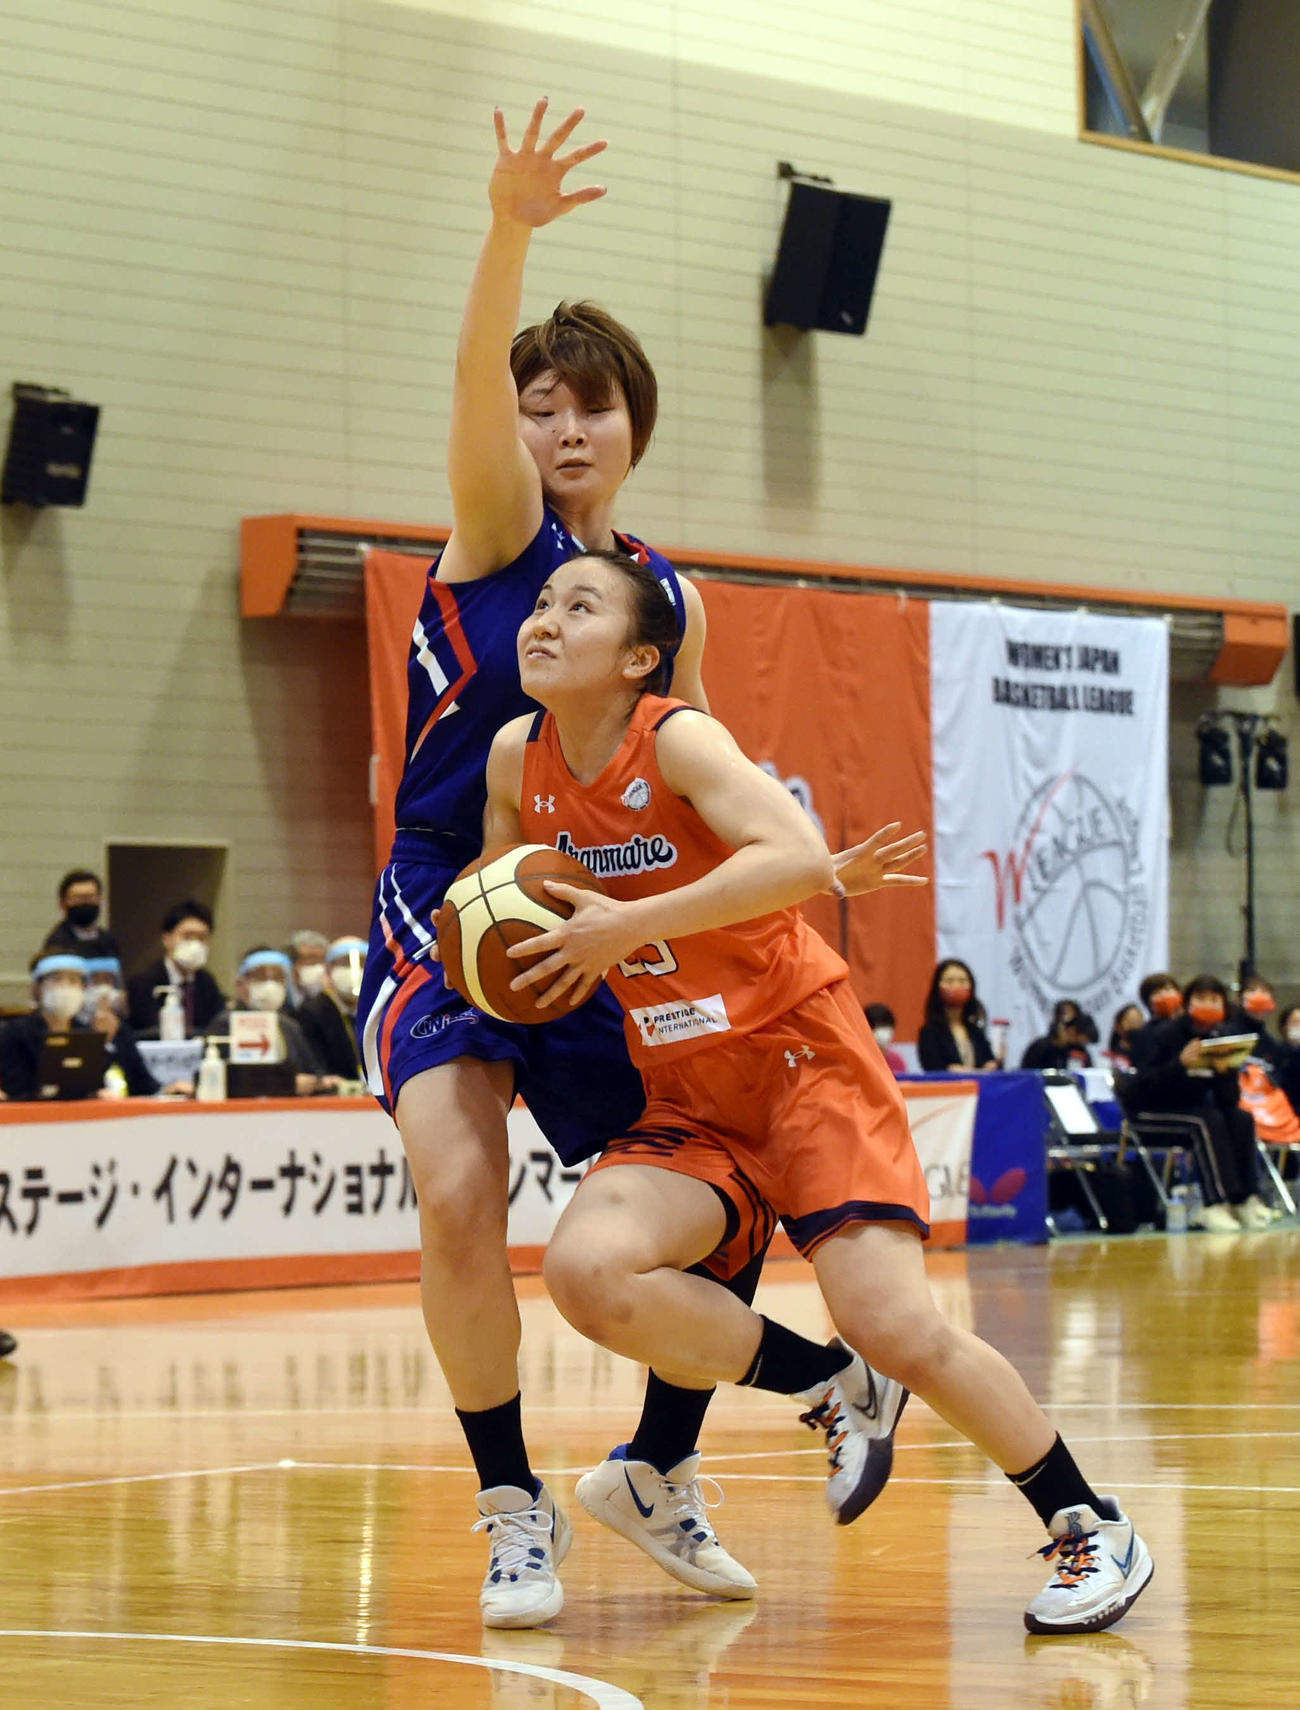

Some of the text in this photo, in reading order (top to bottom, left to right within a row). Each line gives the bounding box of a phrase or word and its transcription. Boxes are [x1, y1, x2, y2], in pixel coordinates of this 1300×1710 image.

[1078, 644, 1120, 675] JAPAN
[992, 676, 1134, 715] BASKETBALL LEAGUE
[653, 1007, 696, 1024] PRESTIGE
[658, 1016, 718, 1034] NTERNATIONAL
